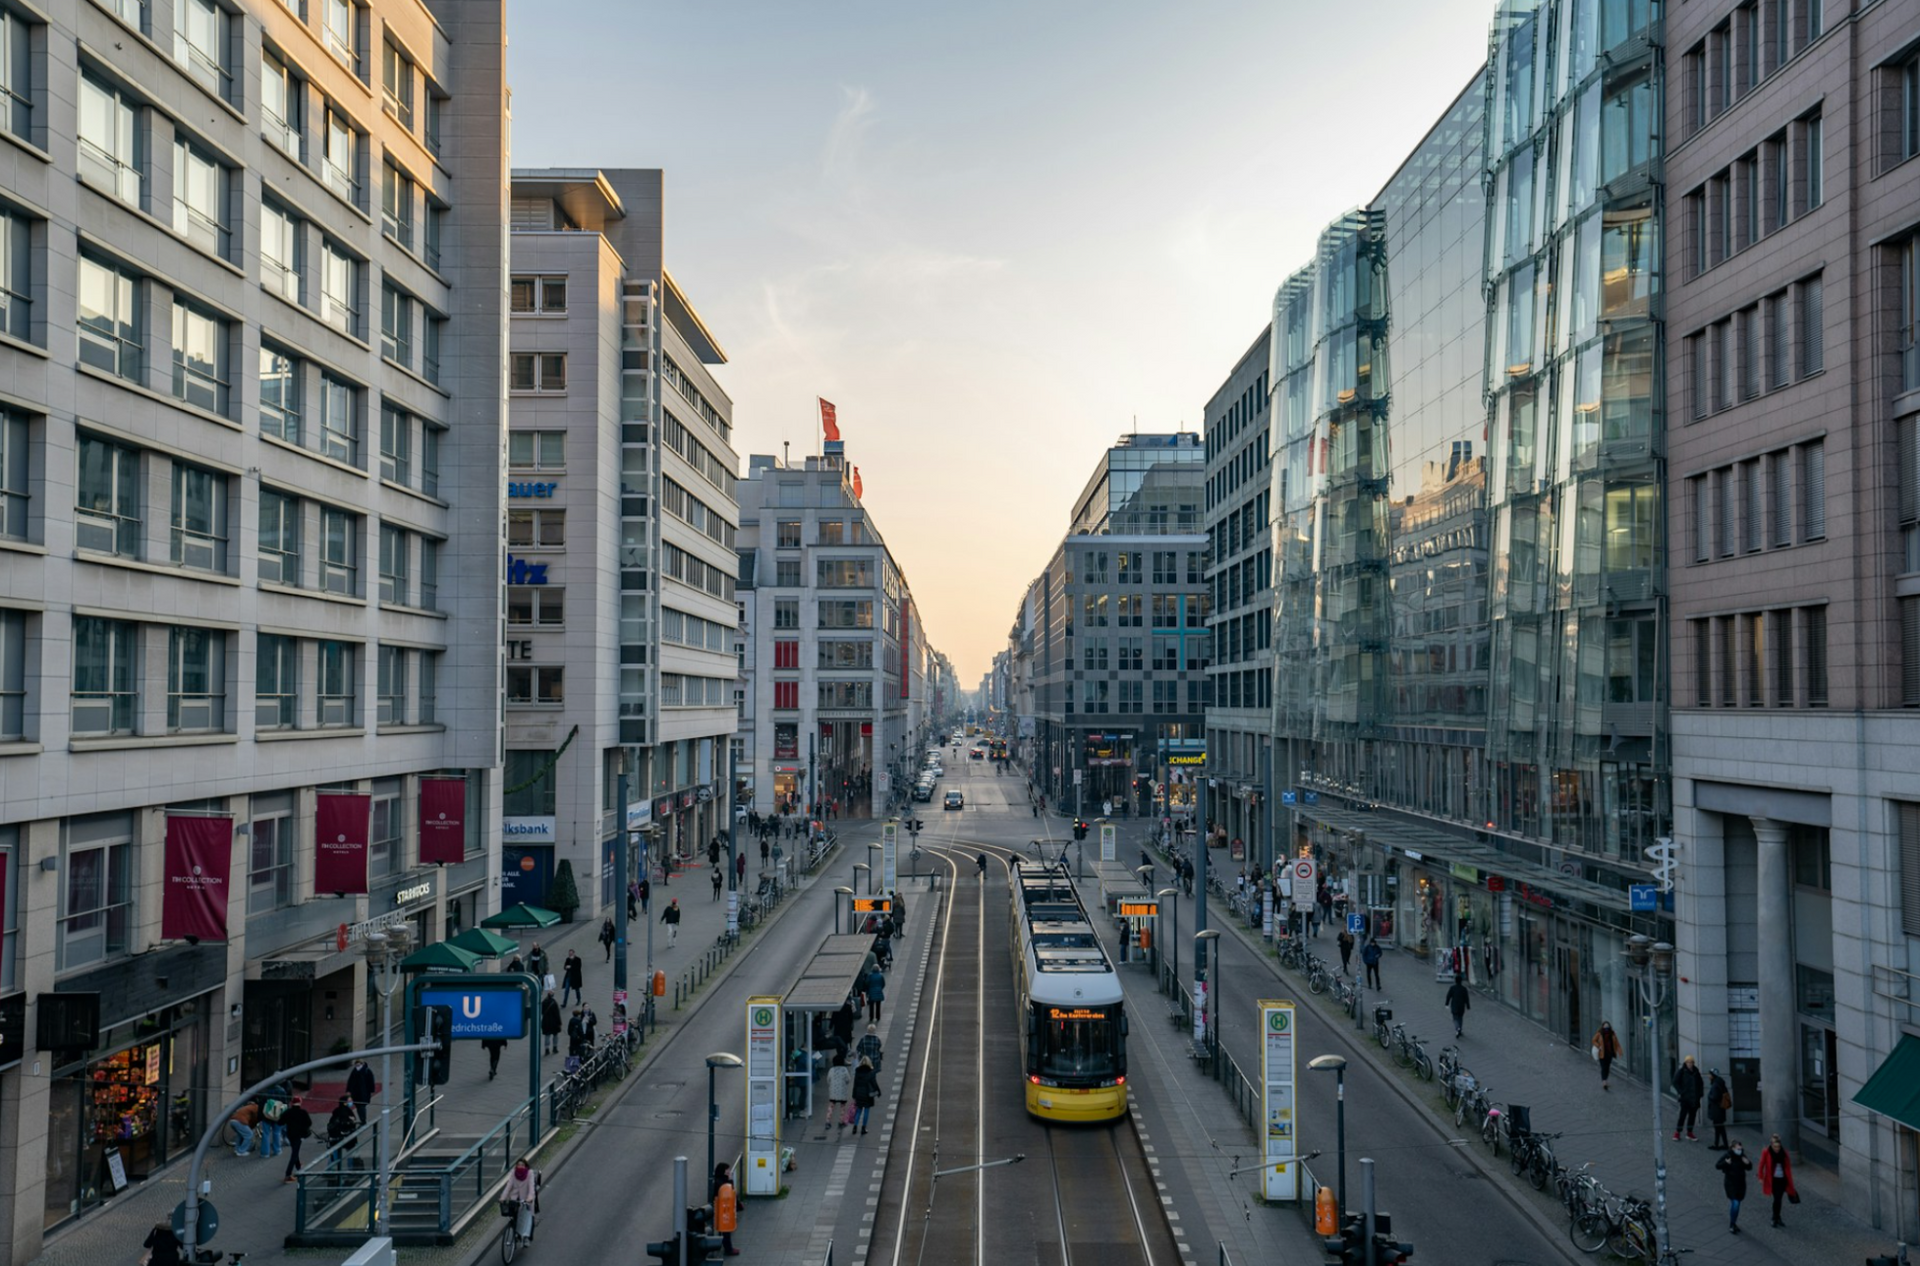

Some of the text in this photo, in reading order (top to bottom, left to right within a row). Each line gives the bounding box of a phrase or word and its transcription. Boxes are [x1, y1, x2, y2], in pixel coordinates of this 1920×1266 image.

[503, 823, 549, 835] lksbank
[181, 876, 223, 884] COLLECTION
[397, 882, 430, 904] STARBUCKS
[1354, 918, 1361, 930] P
[463, 996, 481, 1019] U
[1050, 1008, 1060, 1019] 12
[451, 1022, 503, 1033] edrichstraße
